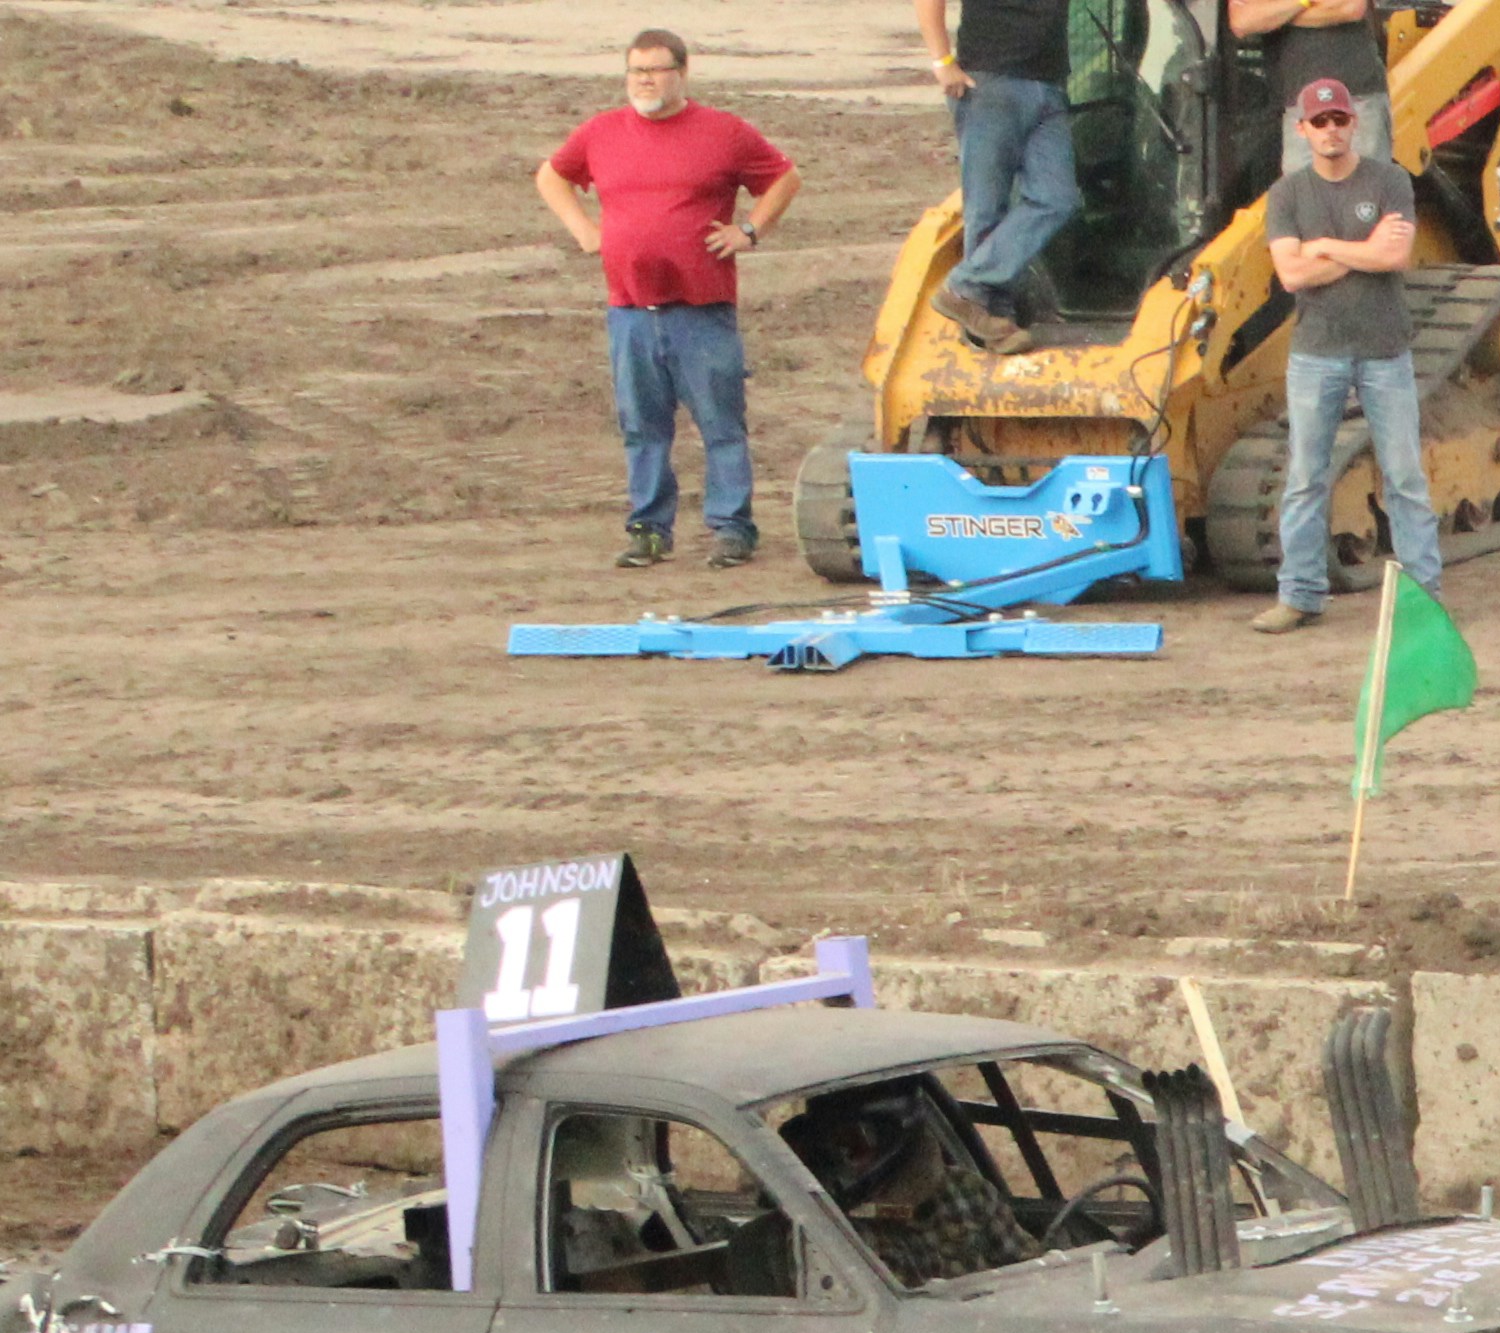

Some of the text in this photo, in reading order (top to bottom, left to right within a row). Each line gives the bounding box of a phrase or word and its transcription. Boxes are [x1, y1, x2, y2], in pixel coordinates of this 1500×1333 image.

[927, 515, 1043, 538] STINGER
[479, 859, 618, 908] JOHNSON
[484, 897, 581, 1022] 11
